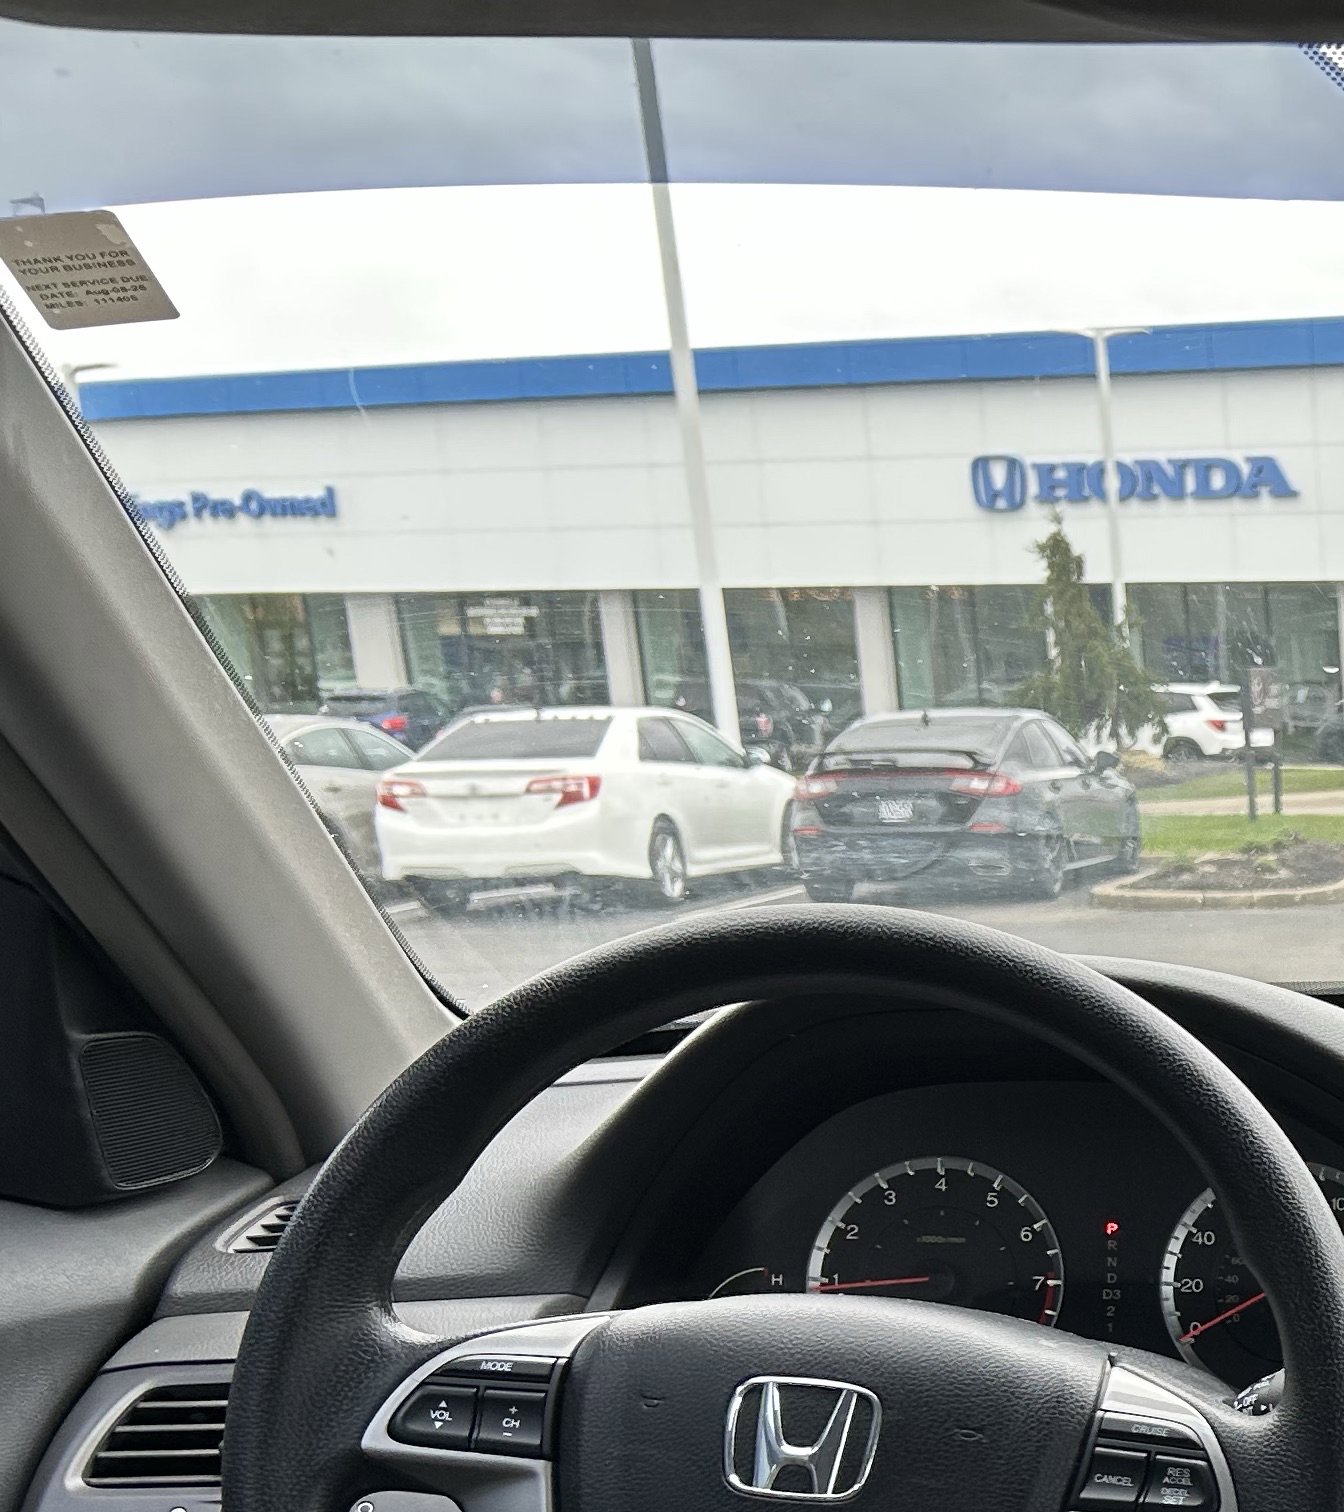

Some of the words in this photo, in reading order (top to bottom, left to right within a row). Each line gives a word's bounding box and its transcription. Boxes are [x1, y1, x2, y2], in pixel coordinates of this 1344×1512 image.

[13, 255, 62, 267] THANK
[65, 252, 97, 262] YOU
[99, 249, 130, 259] FOR
[18, 265, 60, 276] YOUR
[62, 258, 137, 272] BUSINESS
[25, 282, 59, 292] NEXT
[62, 277, 118, 289] SERVICE
[120, 274, 149, 284] DUE
[1031, 456, 1300, 502] HONDA
[935, 1177, 948, 1192] 4
[883, 1189, 897, 1205] 3
[985, 1192, 999, 1208] 5
[845, 1224, 860, 1240] 2
[1019, 1227, 1033, 1242] 6
[1106, 1222, 1119, 1235] P
[1107, 1240, 1118, 1250] R
[1192, 1231, 1216, 1246] 40
[1107, 1257, 1117, 1267] N
[771, 1273, 783, 1286] H
[832, 1273, 840, 1286] 1
[1032, 1276, 1045, 1290] 7
[1107, 1273, 1117, 1284] D
[1181, 1278, 1204, 1293] 20
[1103, 1288, 1121, 1300] D3
[1106, 1305, 1116, 1316] 2
[479, 1360, 513, 1372] MODE
[430, 1408, 452, 1421] VOL
[502, 1417, 520, 1429] CH
[1131, 1424, 1170, 1437] CRUISE
[1166, 1467, 1191, 1477] RES
[1094, 1473, 1134, 1487] CANCEL
